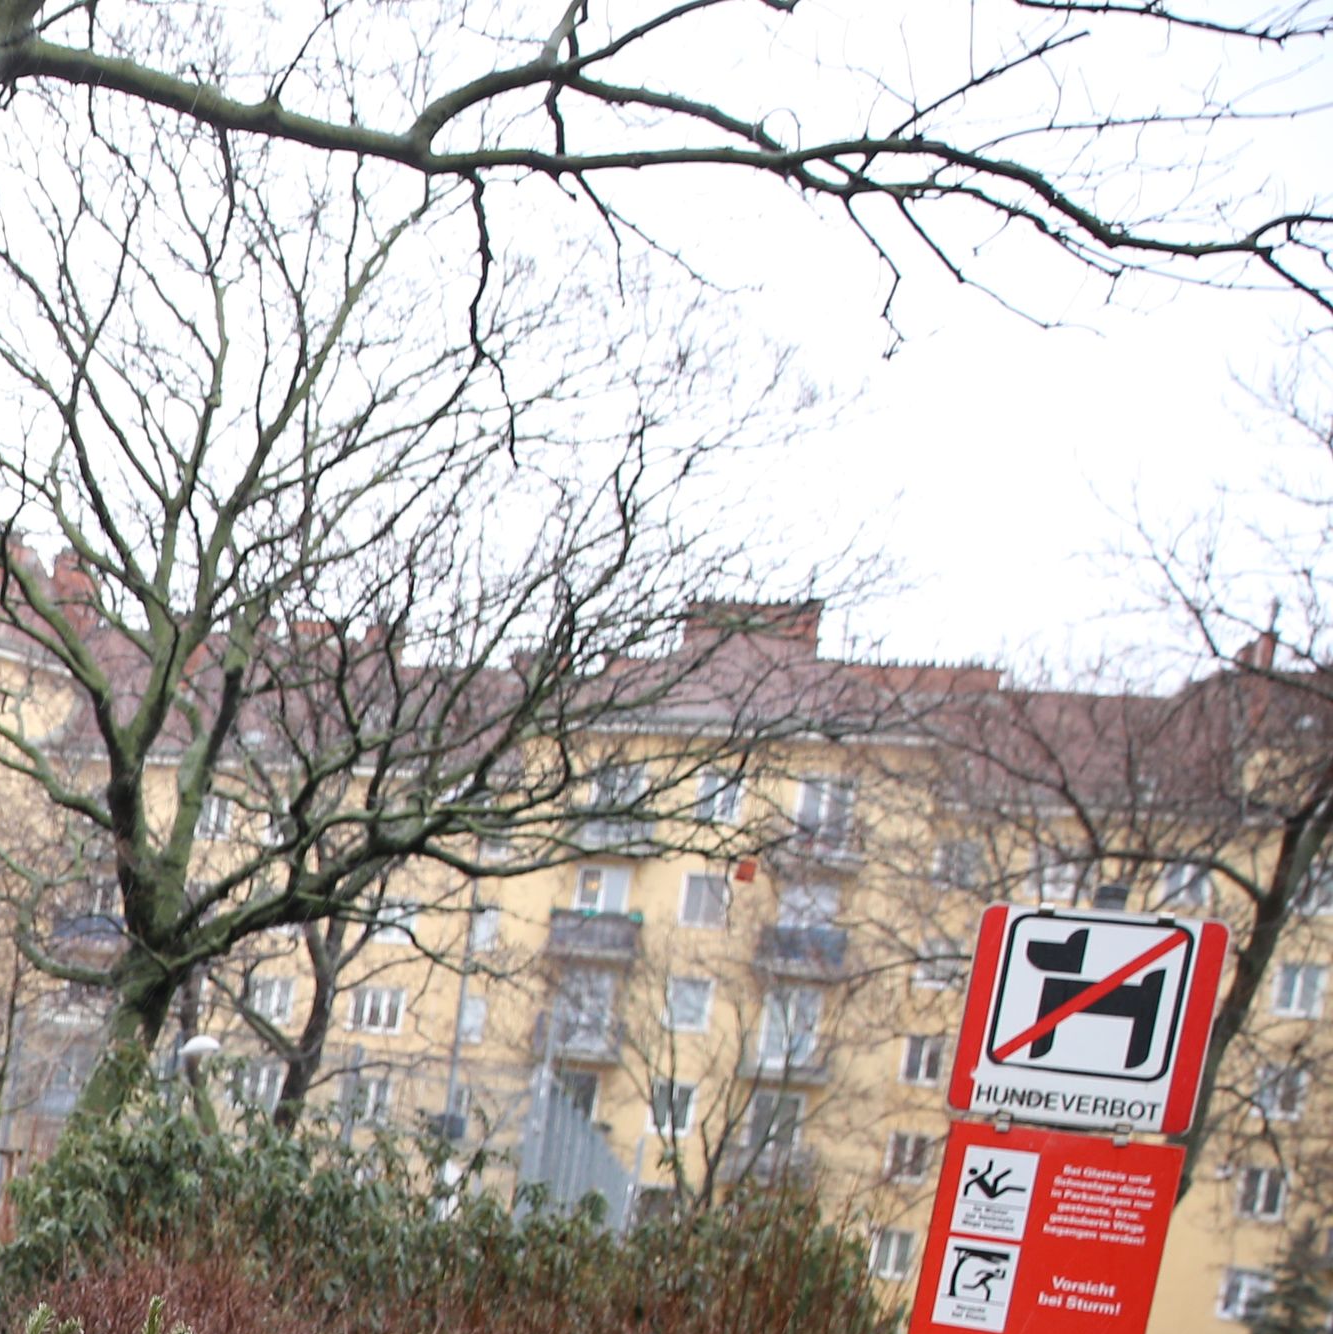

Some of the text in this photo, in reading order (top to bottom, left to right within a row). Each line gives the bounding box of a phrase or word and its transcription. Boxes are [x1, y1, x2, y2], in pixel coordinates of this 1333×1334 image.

[976, 1084, 1162, 1122] HUNDEVERBOT
[1052, 1275, 1116, 1298] Vorsicht
[1037, 1290, 1121, 1316] bei Sturm!
